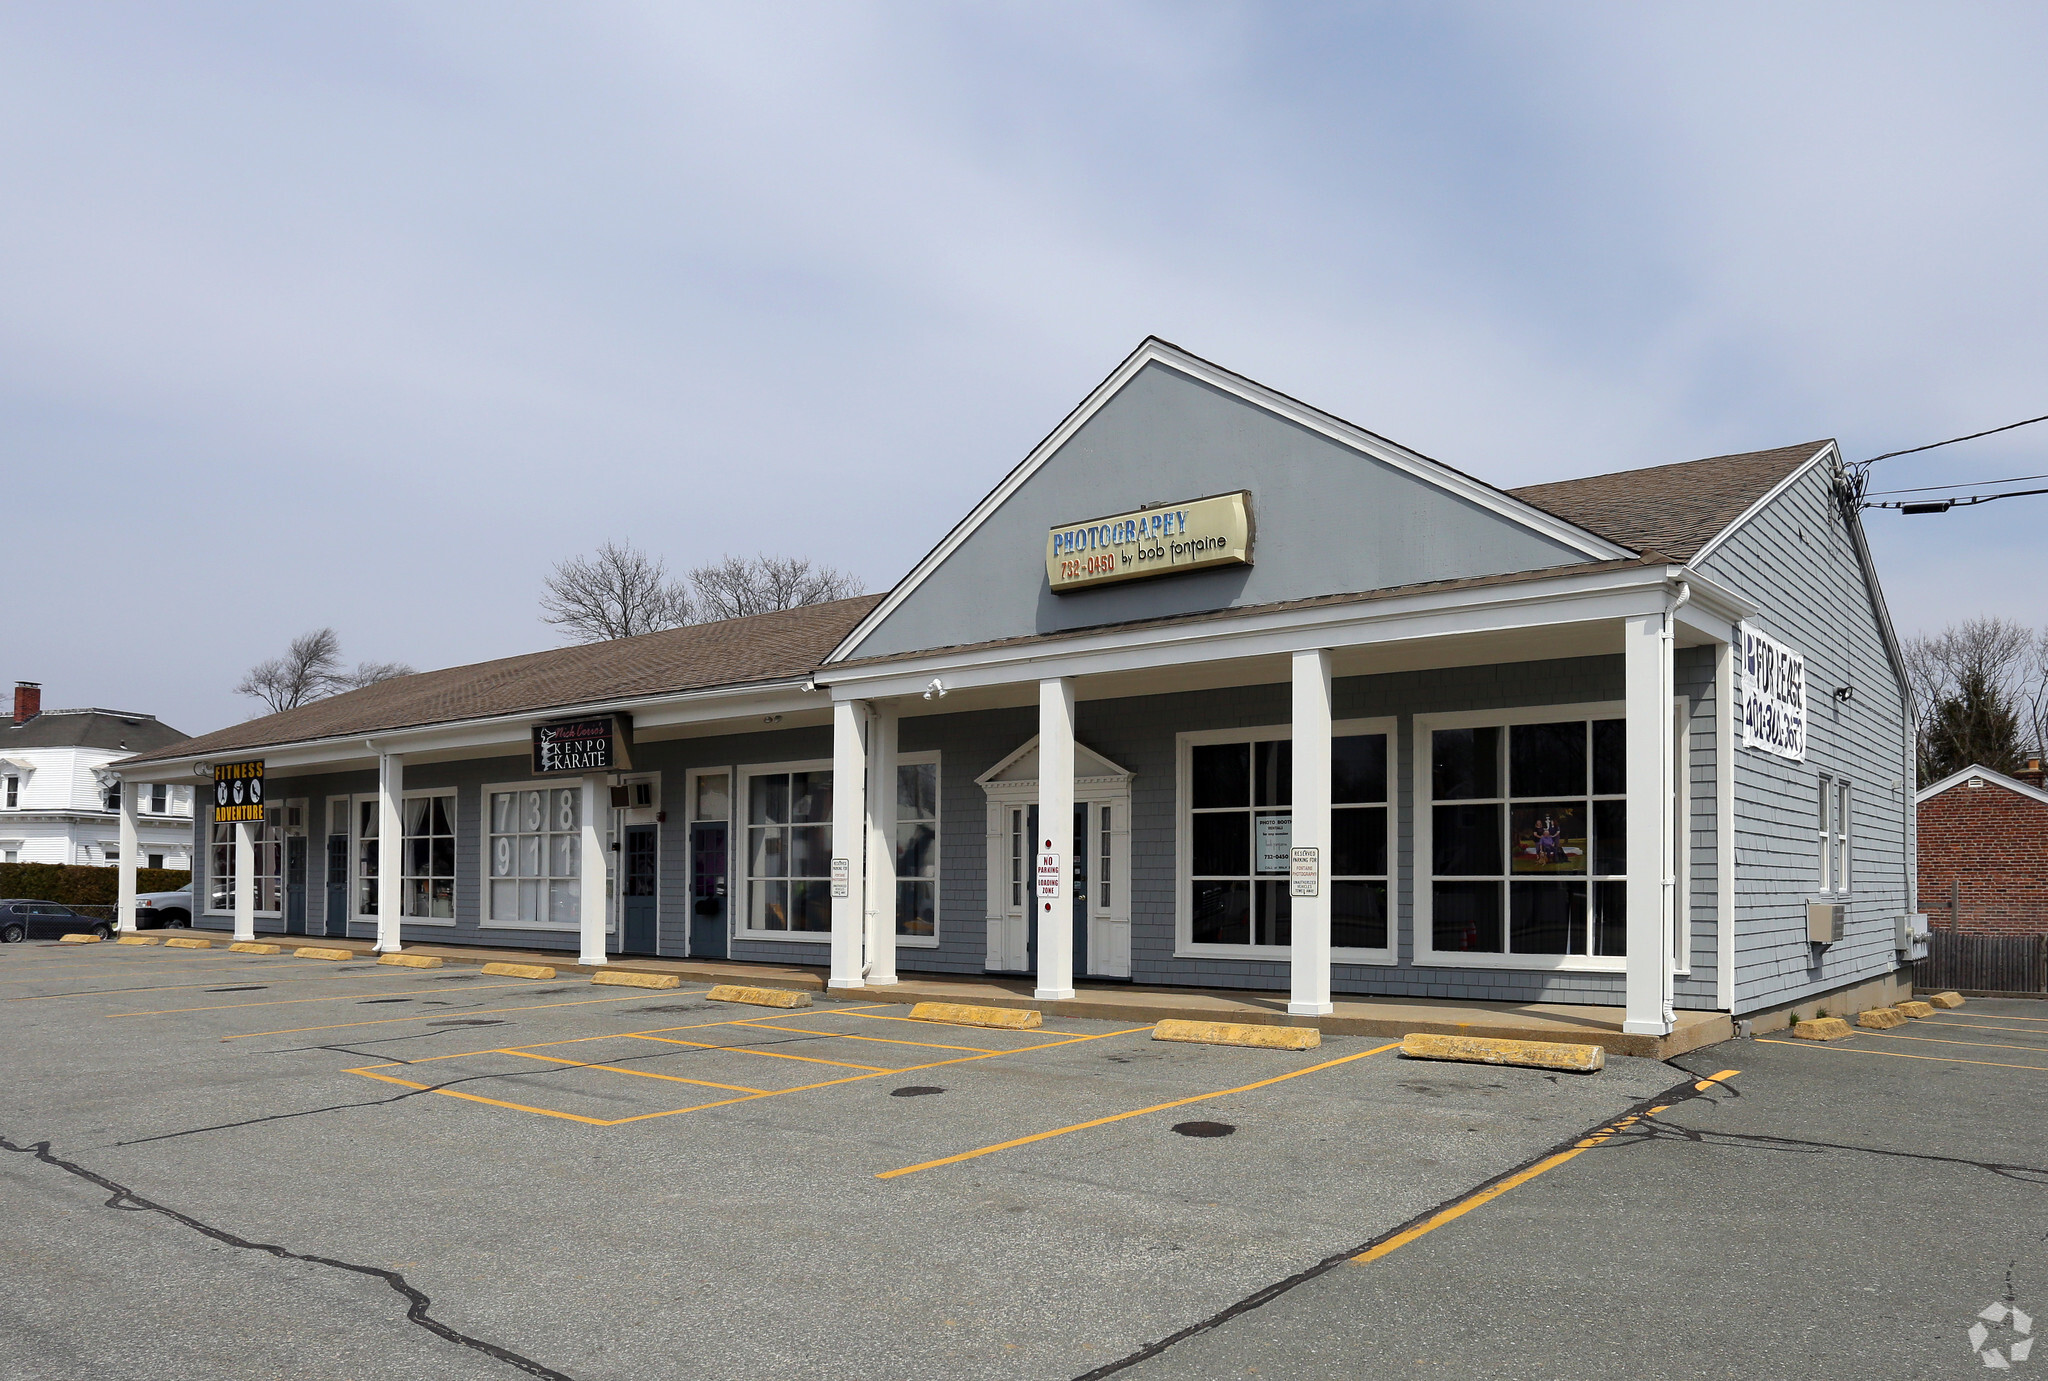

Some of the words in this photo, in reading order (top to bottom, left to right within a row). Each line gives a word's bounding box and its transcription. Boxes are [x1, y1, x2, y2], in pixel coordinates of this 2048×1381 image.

[1053, 509, 1190, 556] PHOTOGRAPHY
[1121, 549, 1134, 565] by
[1138, 540, 1165, 560] bob
[1170, 535, 1227, 563] fontaine
[1061, 553, 1115, 579] 732-0450
[1756, 637, 1775, 698] FOR
[1776, 648, 1803, 710] LEASE
[554, 738, 606, 755] KENPO
[554, 751, 606, 770] KARATE
[215, 762, 263, 780] FITNESS
[216, 804, 263, 822] ADVENTURE
[1037, 866, 1059, 874] PARKING
[1043, 856, 1053, 866] NO
[1037, 879, 1059, 887] LOADING
